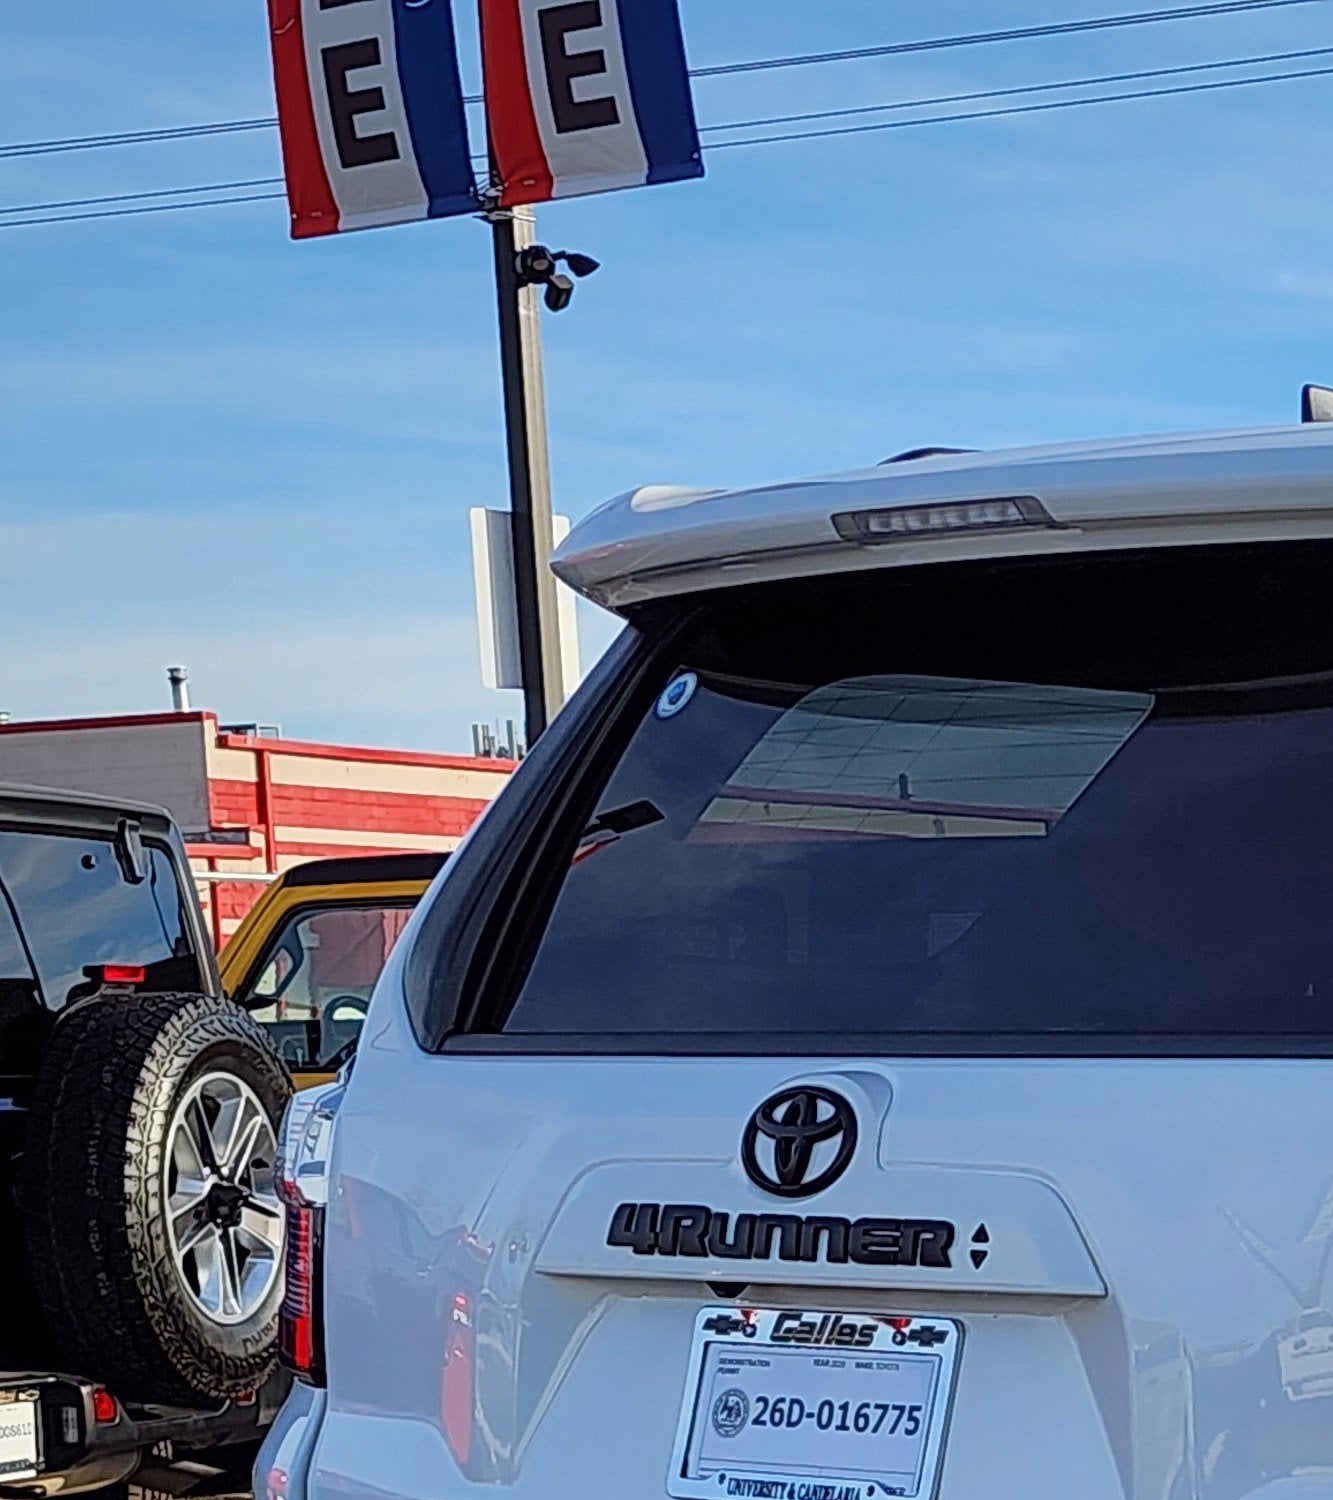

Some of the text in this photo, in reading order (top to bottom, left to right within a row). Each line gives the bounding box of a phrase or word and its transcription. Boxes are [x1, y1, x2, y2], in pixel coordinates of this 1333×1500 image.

[319, 0, 401, 169] E
[606, 1202, 956, 1268] 4RUNNER
[750, 1395, 923, 1437] 26D-016775
[726, 1477, 788, 1500] UNIVERSITY
[786, 1482, 796, 1500] &
